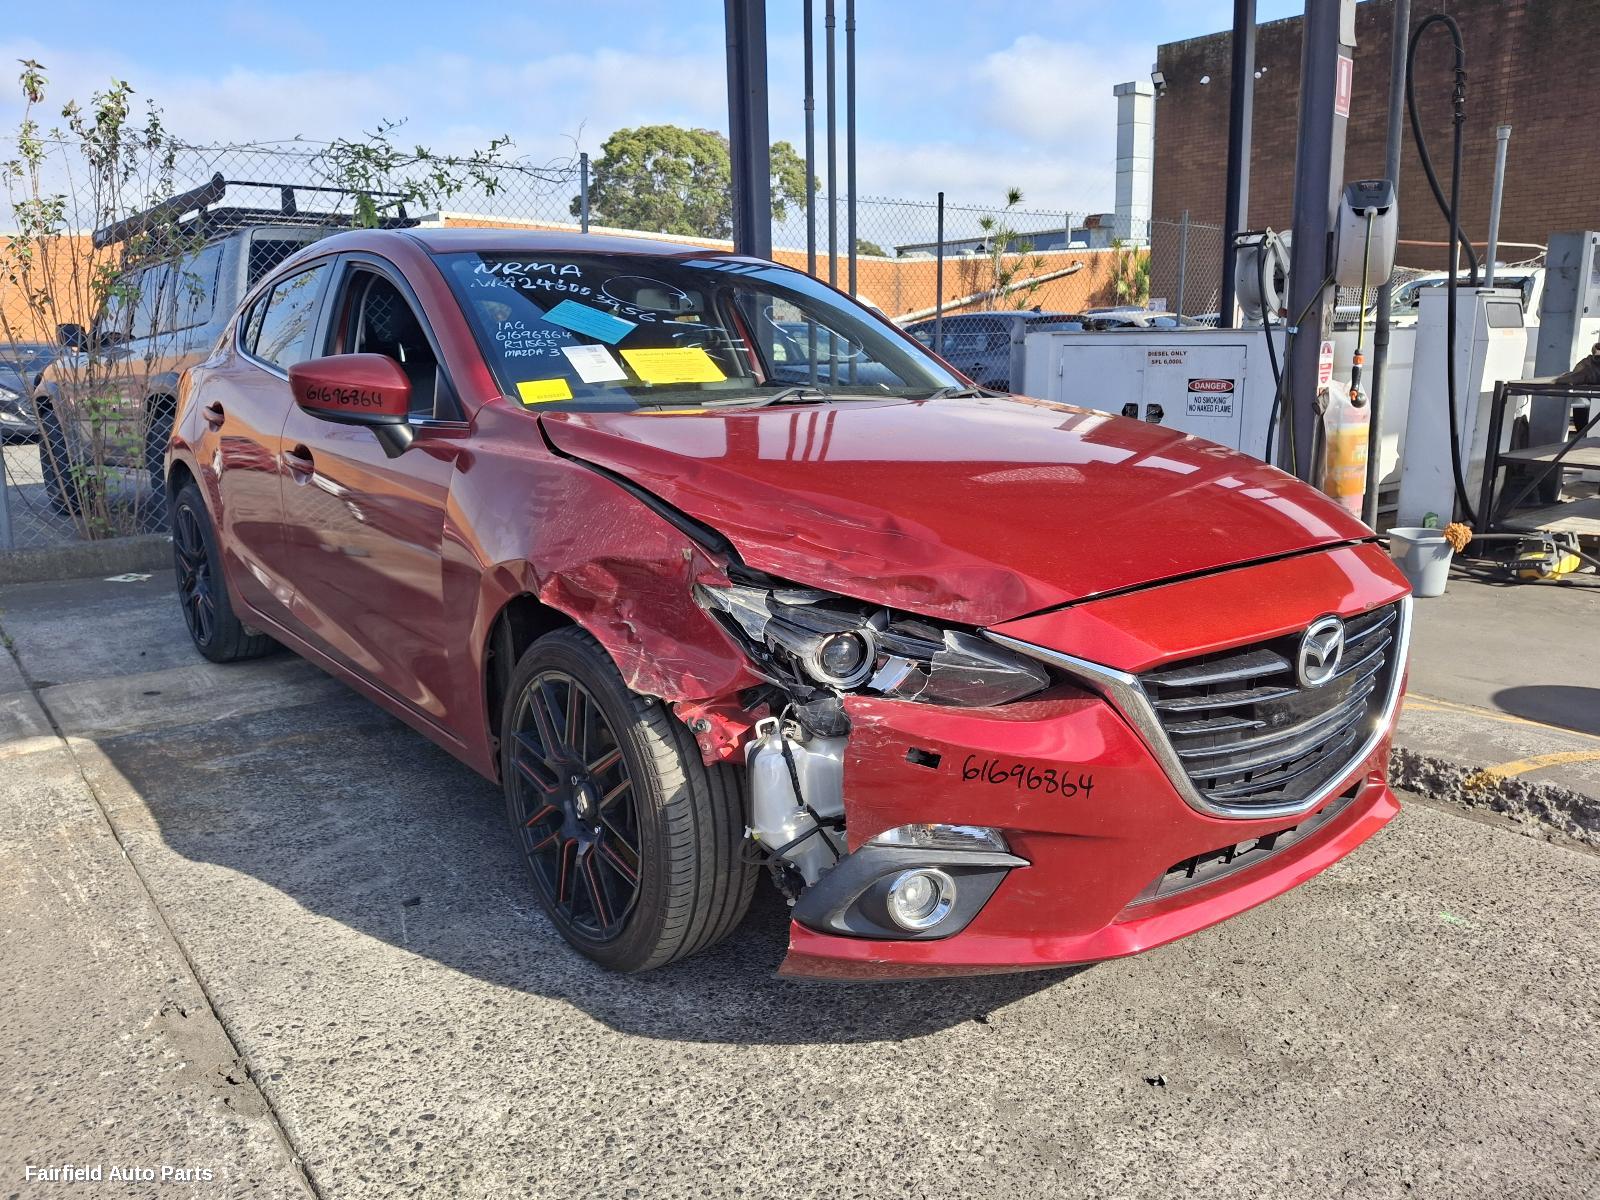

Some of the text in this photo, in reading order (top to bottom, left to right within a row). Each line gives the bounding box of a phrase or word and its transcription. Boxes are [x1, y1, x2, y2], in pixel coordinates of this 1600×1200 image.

[474, 261, 583, 277] NRMA
[498, 320, 525, 331] IAG
[495, 330, 573, 341] 61696864
[504, 348, 561, 358] MAZDA 3
[1194, 382, 1227, 390] DANGER
[306, 384, 383, 408] 61696864
[1194, 396, 1227, 405] NO SMOKING
[1188, 404, 1232, 413] NO NAKED FLAME
[962, 754, 1095, 799] 61696864
